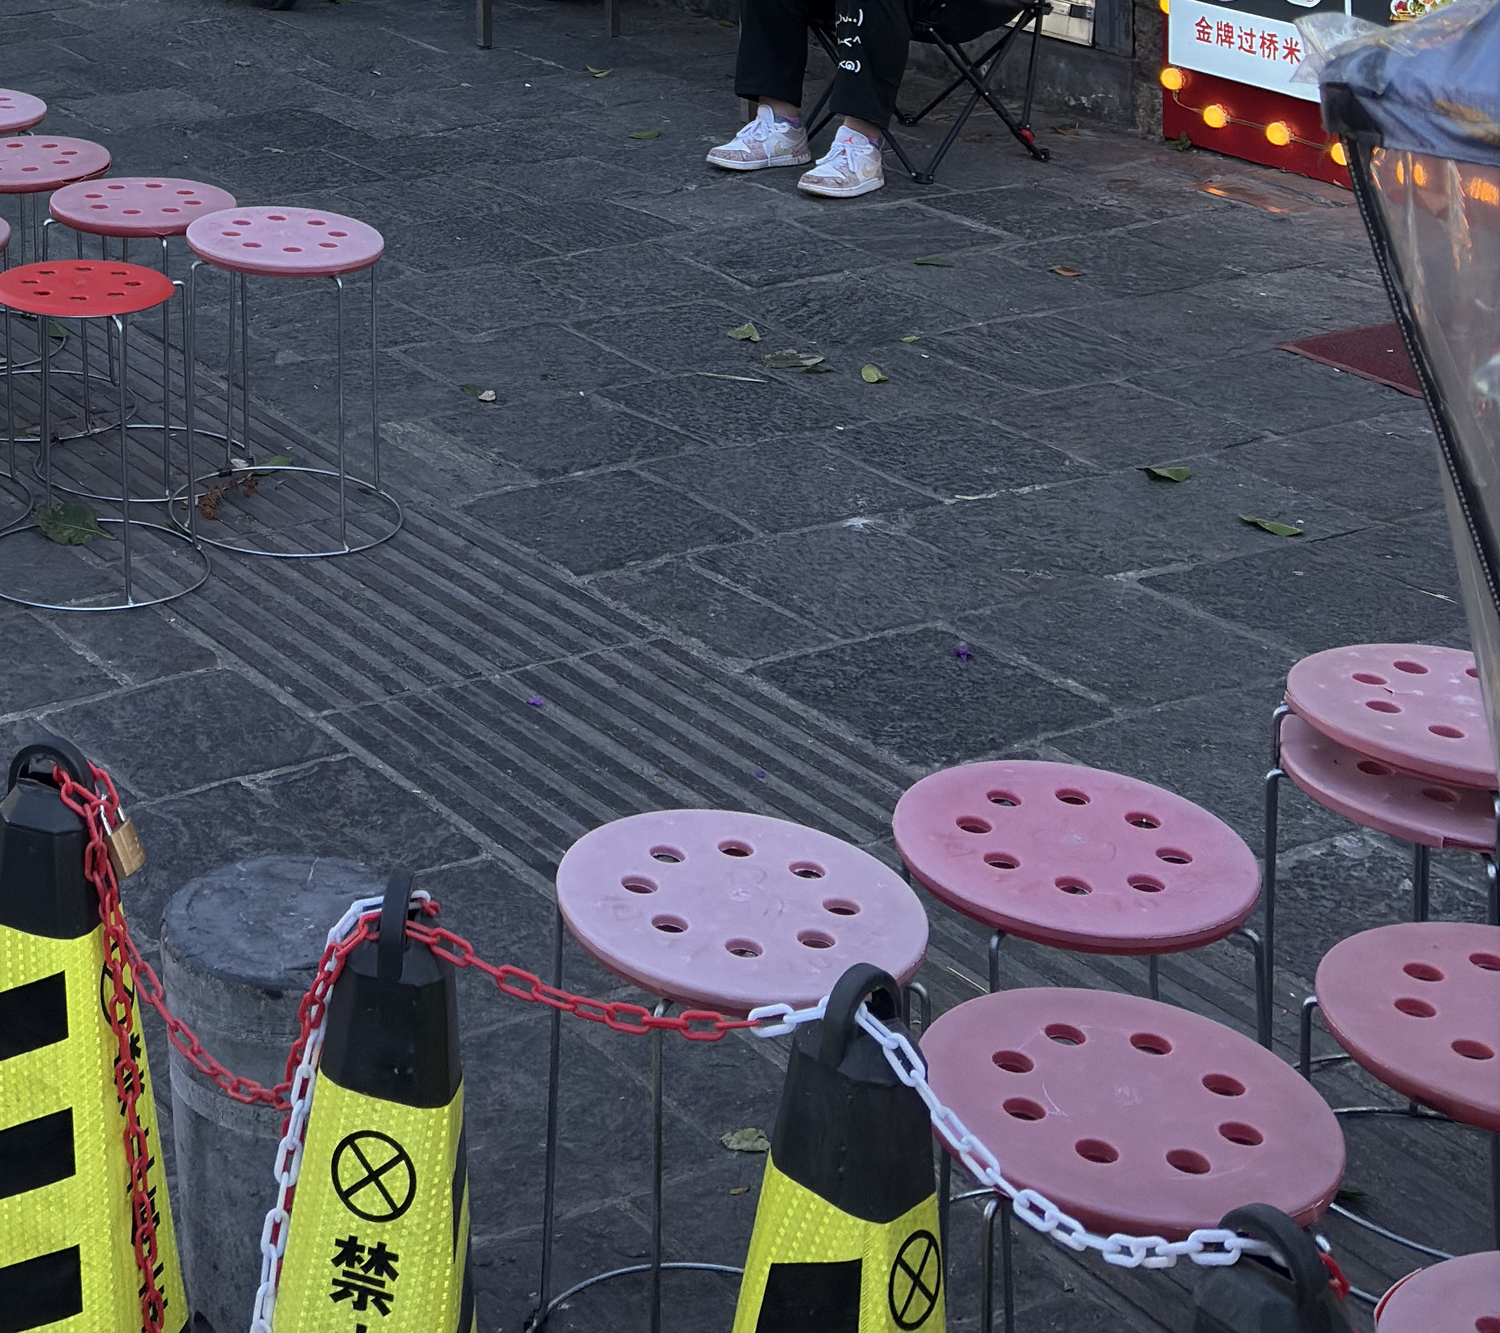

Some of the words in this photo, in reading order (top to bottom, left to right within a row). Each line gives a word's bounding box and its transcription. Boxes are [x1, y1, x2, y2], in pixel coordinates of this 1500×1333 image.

[1195, 16, 1301, 66] 金牌过桥米
